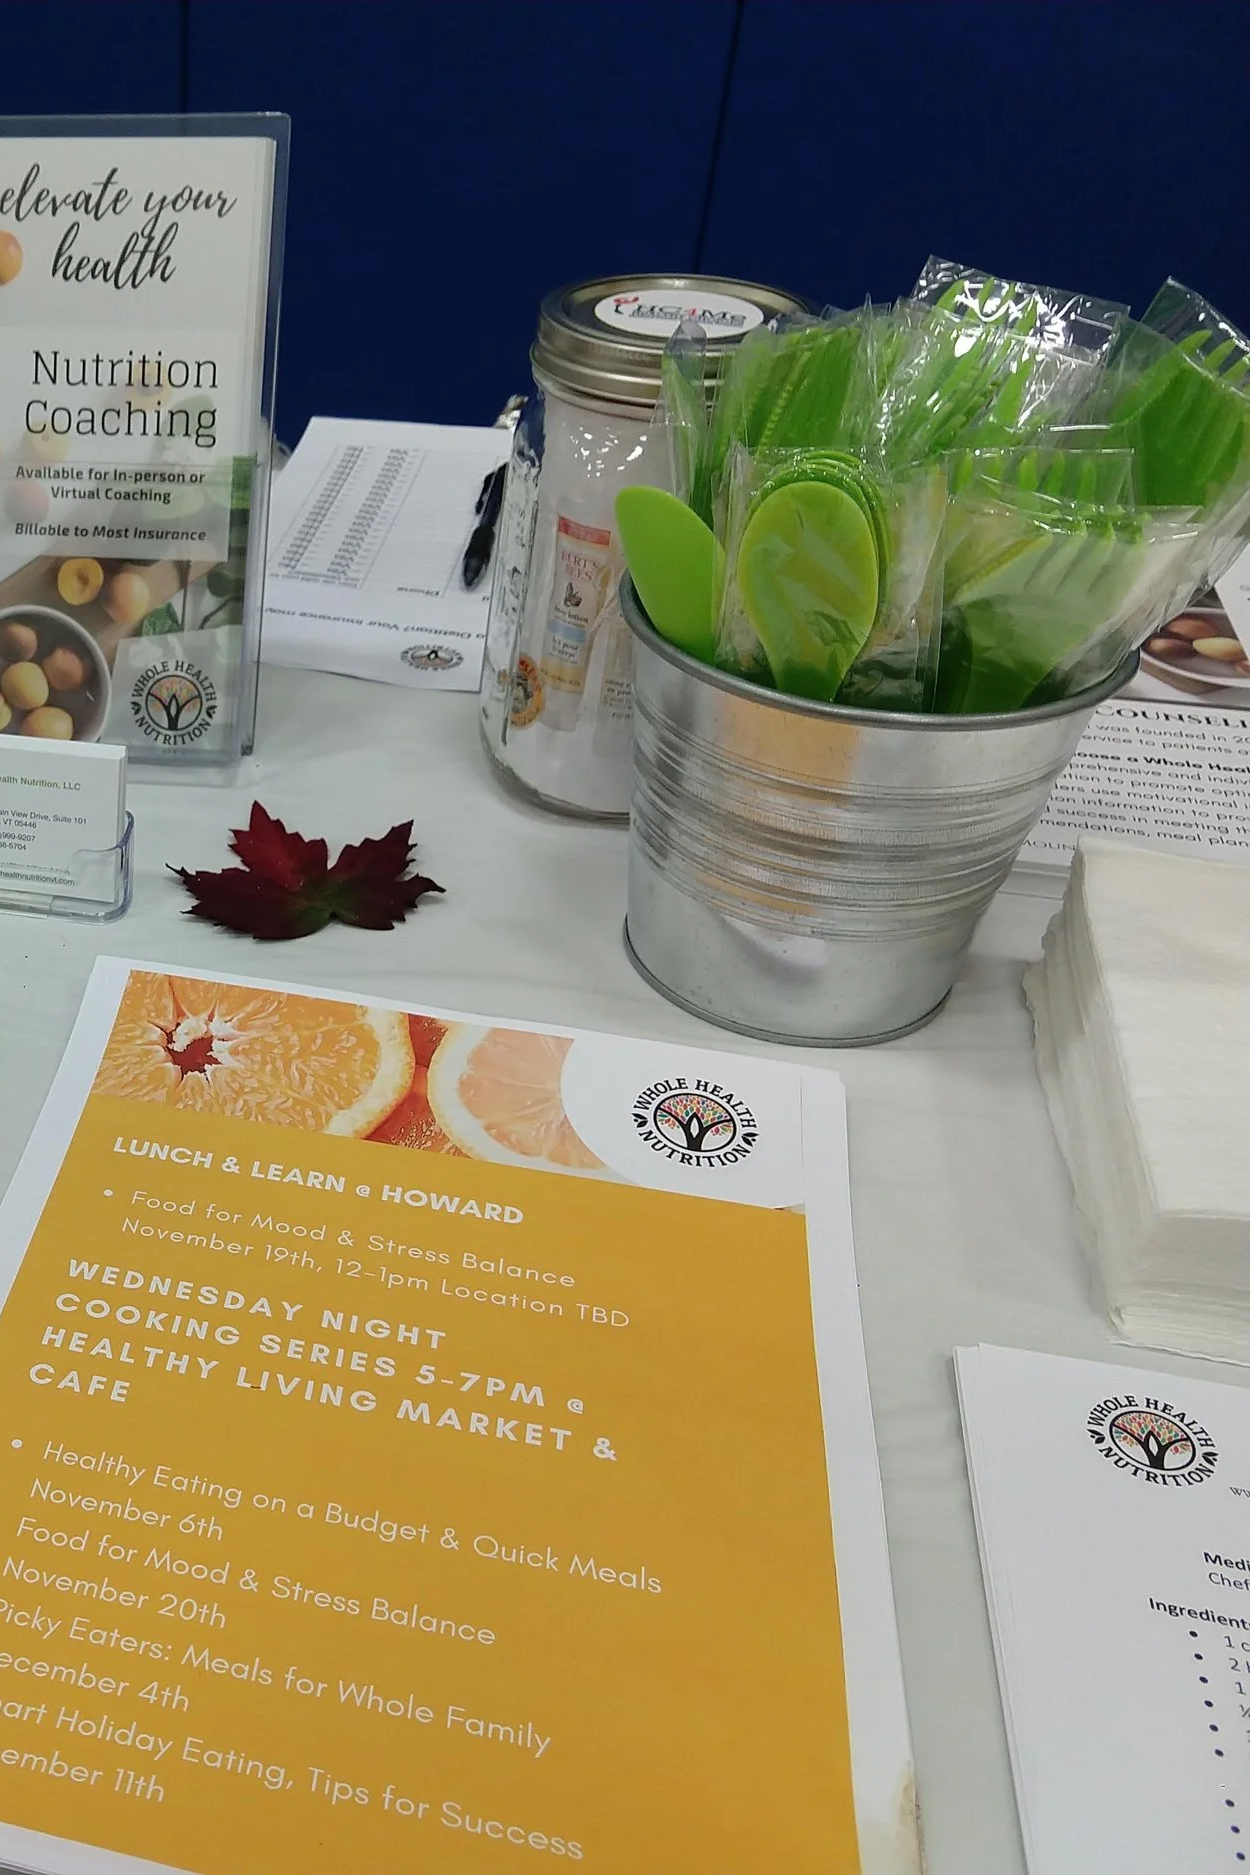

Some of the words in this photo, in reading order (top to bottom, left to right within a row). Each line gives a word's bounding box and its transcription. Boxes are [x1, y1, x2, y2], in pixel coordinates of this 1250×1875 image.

[0, 163, 132, 221] elevate
[142, 184, 239, 242] your
[51, 221, 179, 289] health
[32, 350, 218, 388] Nutrition
[25, 399, 217, 448] Coaching
[15, 466, 83, 481] Available
[88, 466, 110, 482] for
[113, 469, 186, 486] In-person
[190, 473, 206, 483] or
[50, 486, 101, 502] Virtual
[104, 488, 171, 504] Coaching
[14, 522, 71, 538] Billable
[72, 523, 90, 538] to
[92, 525, 129, 539] Most
[133, 526, 207, 541] Insurance
[132, 661, 169, 698] WHOLE
[174, 661, 216, 703] HEALTH
[135, 715, 211, 746] NUTRITION
[1096, 724, 1130, 733] was
[1136, 725, 1206, 741] founded
[1212, 733, 1227, 742] in
[1139, 738, 1156, 747] to
[1162, 741, 1233, 754] patients
[1143, 755, 1203, 769] Whole
[1168, 771, 1201, 781] and
[20, 776, 61, 790] Nutrition,
[62, 781, 81, 791] LLC
[1107, 777, 1125, 785] to
[1130, 780, 1205, 794] promote
[1082, 797, 1185, 815] information
[1192, 809, 1209, 819] to
[1091, 788, 1121, 797] use
[1127, 790, 1237, 809] motivational
[2, 818, 12, 826] VT
[13, 819, 38, 829] 05446
[10, 809, 29, 819] View
[29, 811, 51, 822] Drive,
[52, 814, 72, 824] Suite
[73, 816, 87, 825] 101
[1056, 809, 1127, 821] success
[1132, 816, 1148, 824] in
[1154, 818, 1229, 835] meeting
[1156, 830, 1202, 842] meal
[633, 1077, 689, 1111] WHOLE
[695, 1079, 758, 1129] HEALTH
[638, 1129, 752, 1168] NUTRITION
[114, 1137, 213, 1168] LUNCH
[222, 1157, 240, 1174] &
[251, 1161, 345, 1192] LEARN
[382, 1185, 523, 1223] HOWARD
[122, 1218, 253, 1255] November
[266, 1245, 321, 1272] 19th,
[337, 1259, 427, 1290] 12-1pm
[442, 1279, 562, 1315] Location
[576, 1304, 629, 1326] TBD
[70, 1259, 302, 1321] WEDNESDAY
[322, 1310, 445, 1349] NIGHT
[56, 1294, 239, 1345] COOKING
[260, 1335, 395, 1376] SERIES
[415, 1365, 544, 1406] 5-7PM
[30, 1364, 130, 1402] CAFE
[42, 1326, 219, 1379] HEALTHY
[237, 1367, 376, 1411] LIVING
[397, 1399, 572, 1450] MARKET
[593, 1437, 617, 1461] &
[44, 1441, 145, 1486] Healthy
[153, 1466, 242, 1508] Eating
[253, 1494, 286, 1512] on
[297, 1504, 314, 1519] a
[326, 1503, 429, 1542] Budget
[440, 1528, 459, 1550] &
[474, 1535, 558, 1571] Quick
[569, 1554, 661, 1593] Meals
